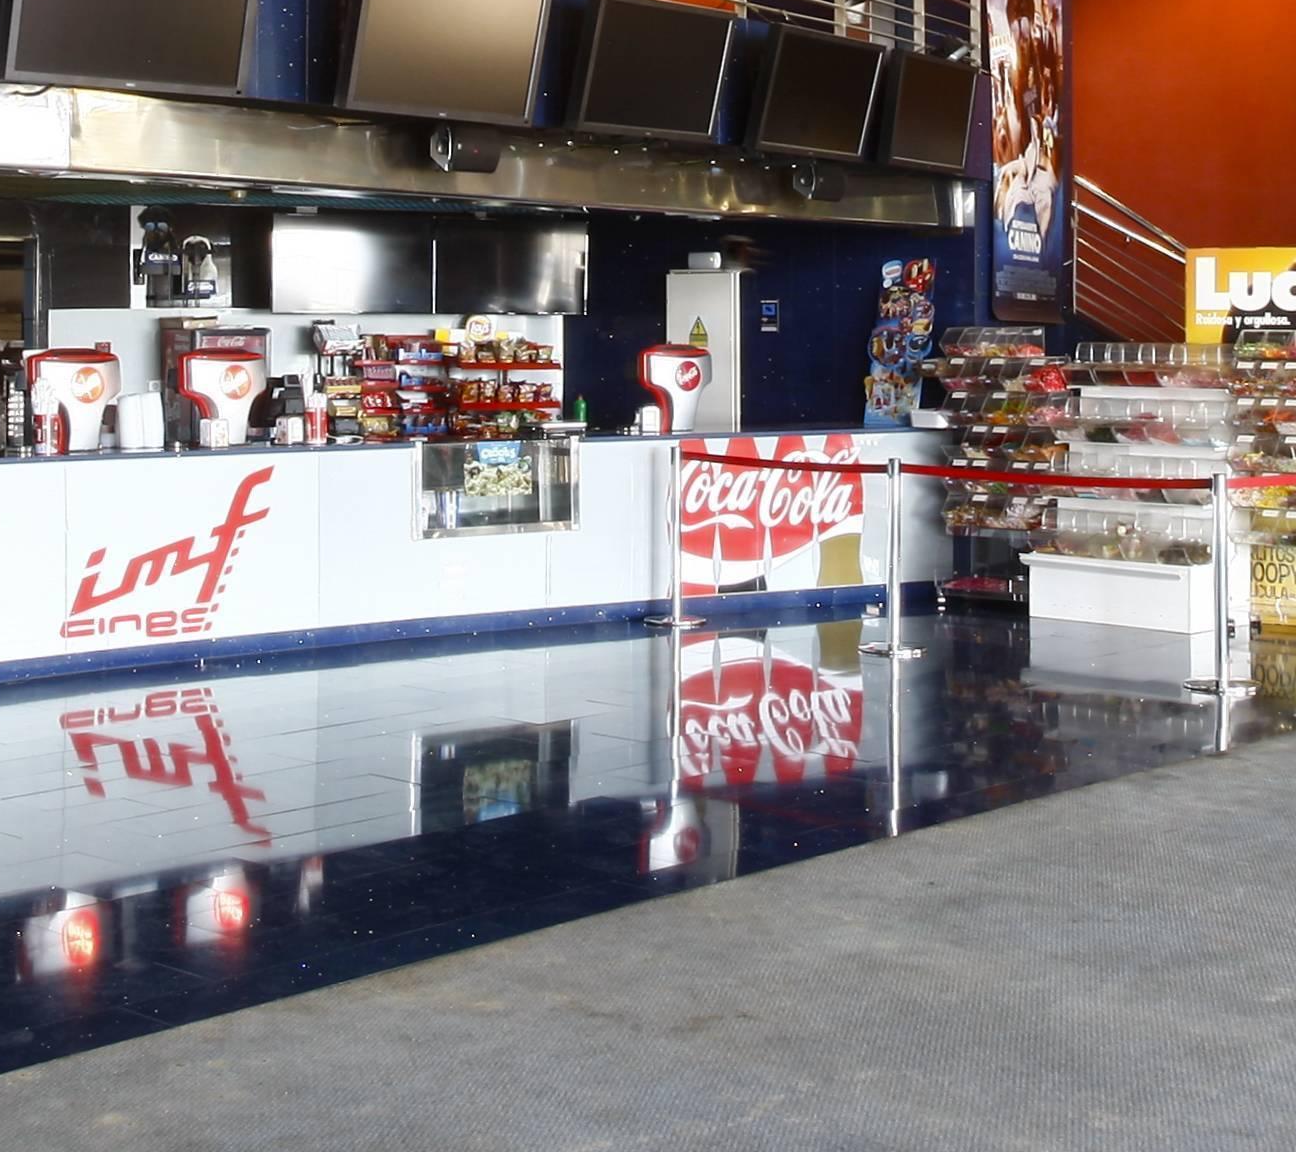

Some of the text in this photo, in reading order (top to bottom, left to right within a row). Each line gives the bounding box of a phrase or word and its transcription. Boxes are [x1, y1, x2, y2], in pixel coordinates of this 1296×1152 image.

[1235, 316, 1242, 328] y
[69, 465, 275, 617] imf
[59, 608, 212, 639] cines
